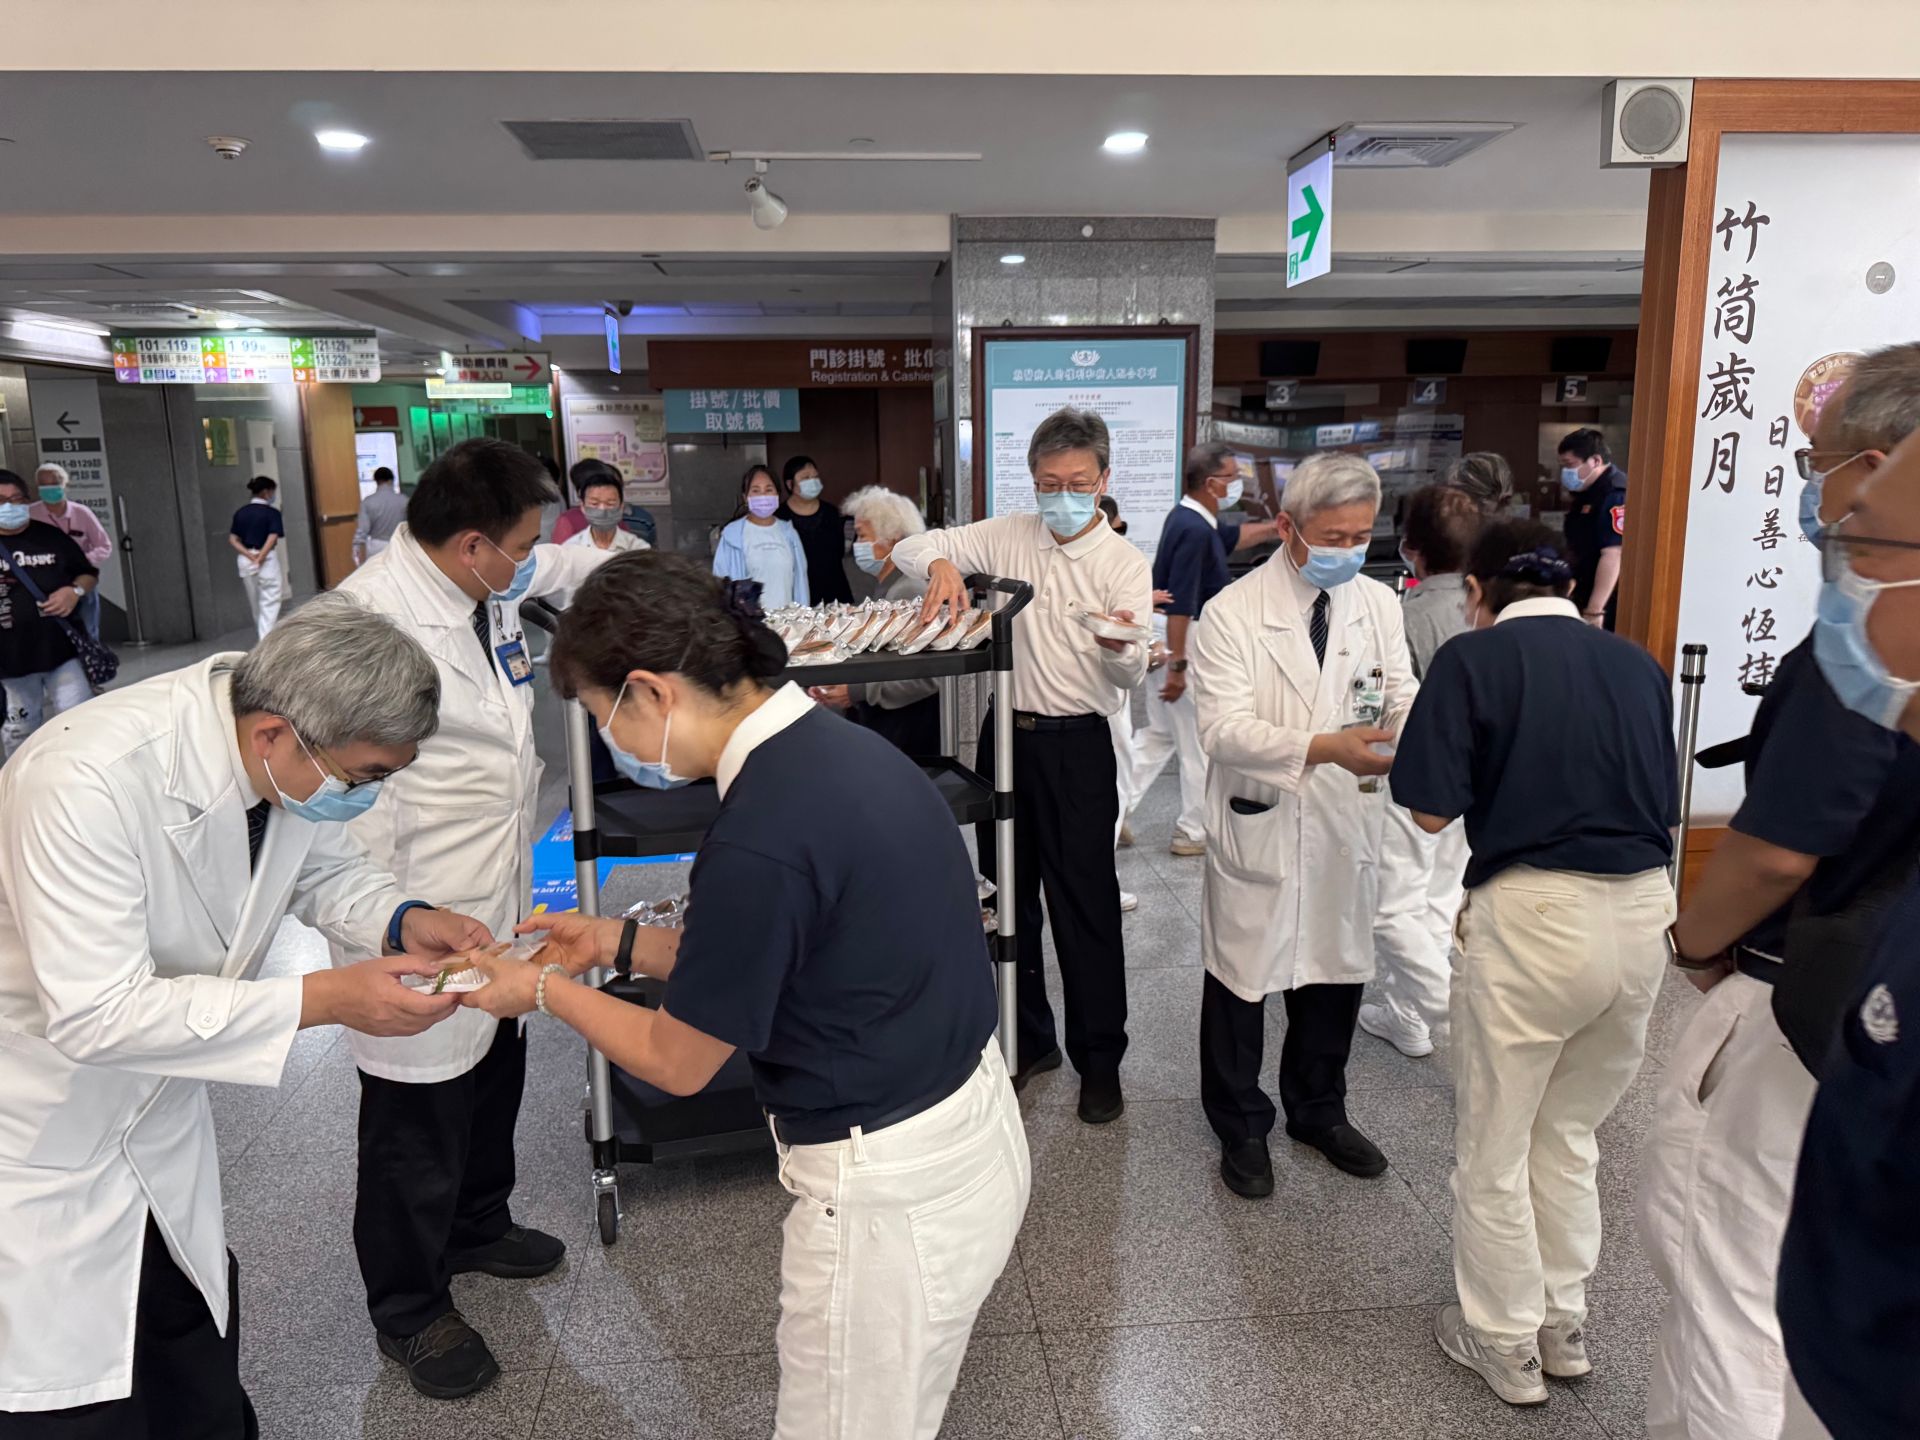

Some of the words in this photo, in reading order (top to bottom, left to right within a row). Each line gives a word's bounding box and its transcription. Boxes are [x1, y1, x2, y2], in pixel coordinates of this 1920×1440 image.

[1701, 201, 1770, 494] 竹筒歲月
[811, 370, 879, 385] Registration
[880, 370, 890, 382] &
[1275, 385, 1290, 404] 3
[1422, 381, 1438, 401] 4
[1564, 380, 1579, 399] 5
[689, 390, 781, 410] 掛號/批價
[705, 411, 765, 432] 取號機
[62, 440, 80, 451] B1
